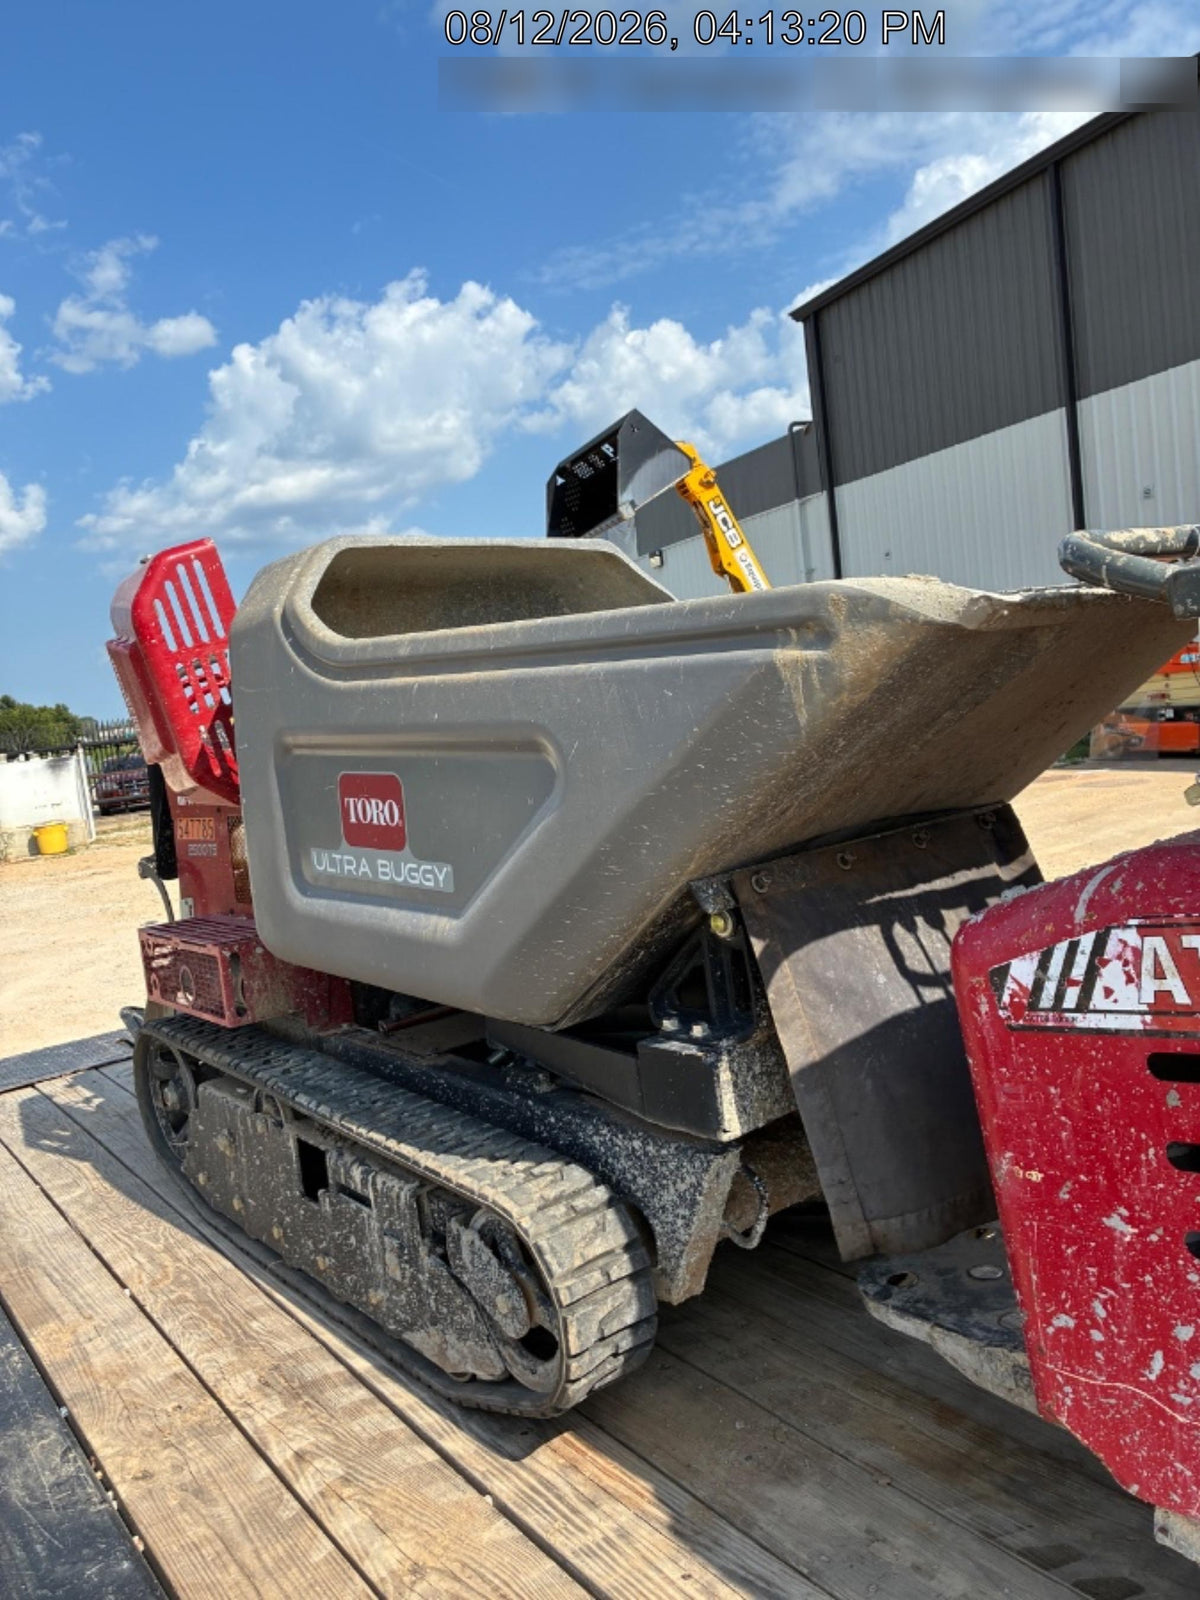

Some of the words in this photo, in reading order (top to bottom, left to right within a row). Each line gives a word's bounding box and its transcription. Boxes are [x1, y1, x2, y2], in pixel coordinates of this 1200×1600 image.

[708, 498, 743, 550] JCB
[344, 797, 400, 827] TORO
[313, 851, 373, 879] ULTRA
[376, 859, 448, 889] BUGGY
